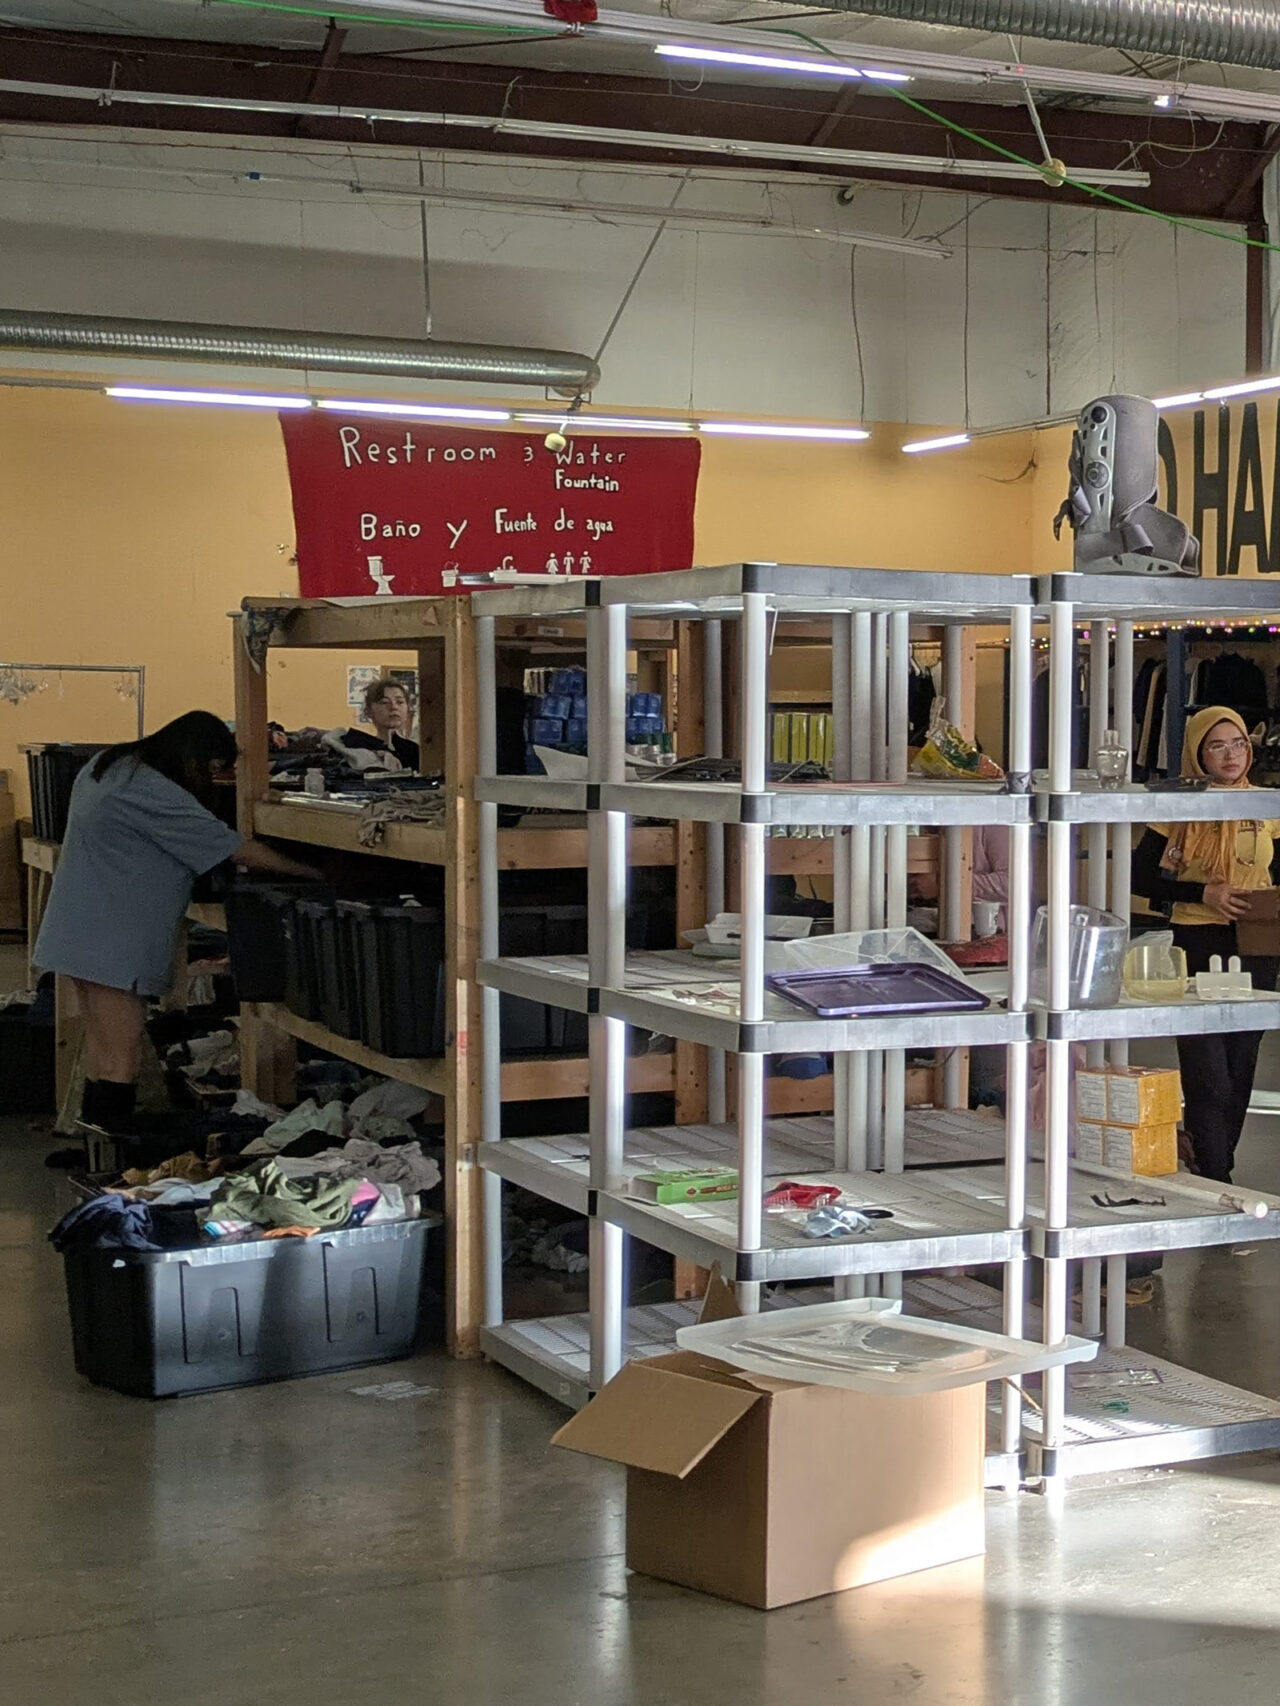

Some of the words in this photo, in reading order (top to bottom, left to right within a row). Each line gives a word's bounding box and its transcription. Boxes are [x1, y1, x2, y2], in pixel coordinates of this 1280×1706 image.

[339, 426, 497, 468] Restroom
[556, 440, 627, 466] Water
[555, 469, 620, 492] Fountain
[360, 513, 422, 541] Baño
[495, 508, 538, 534] Fuente
[554, 507, 575, 532] de
[586, 518, 614, 541] agua
